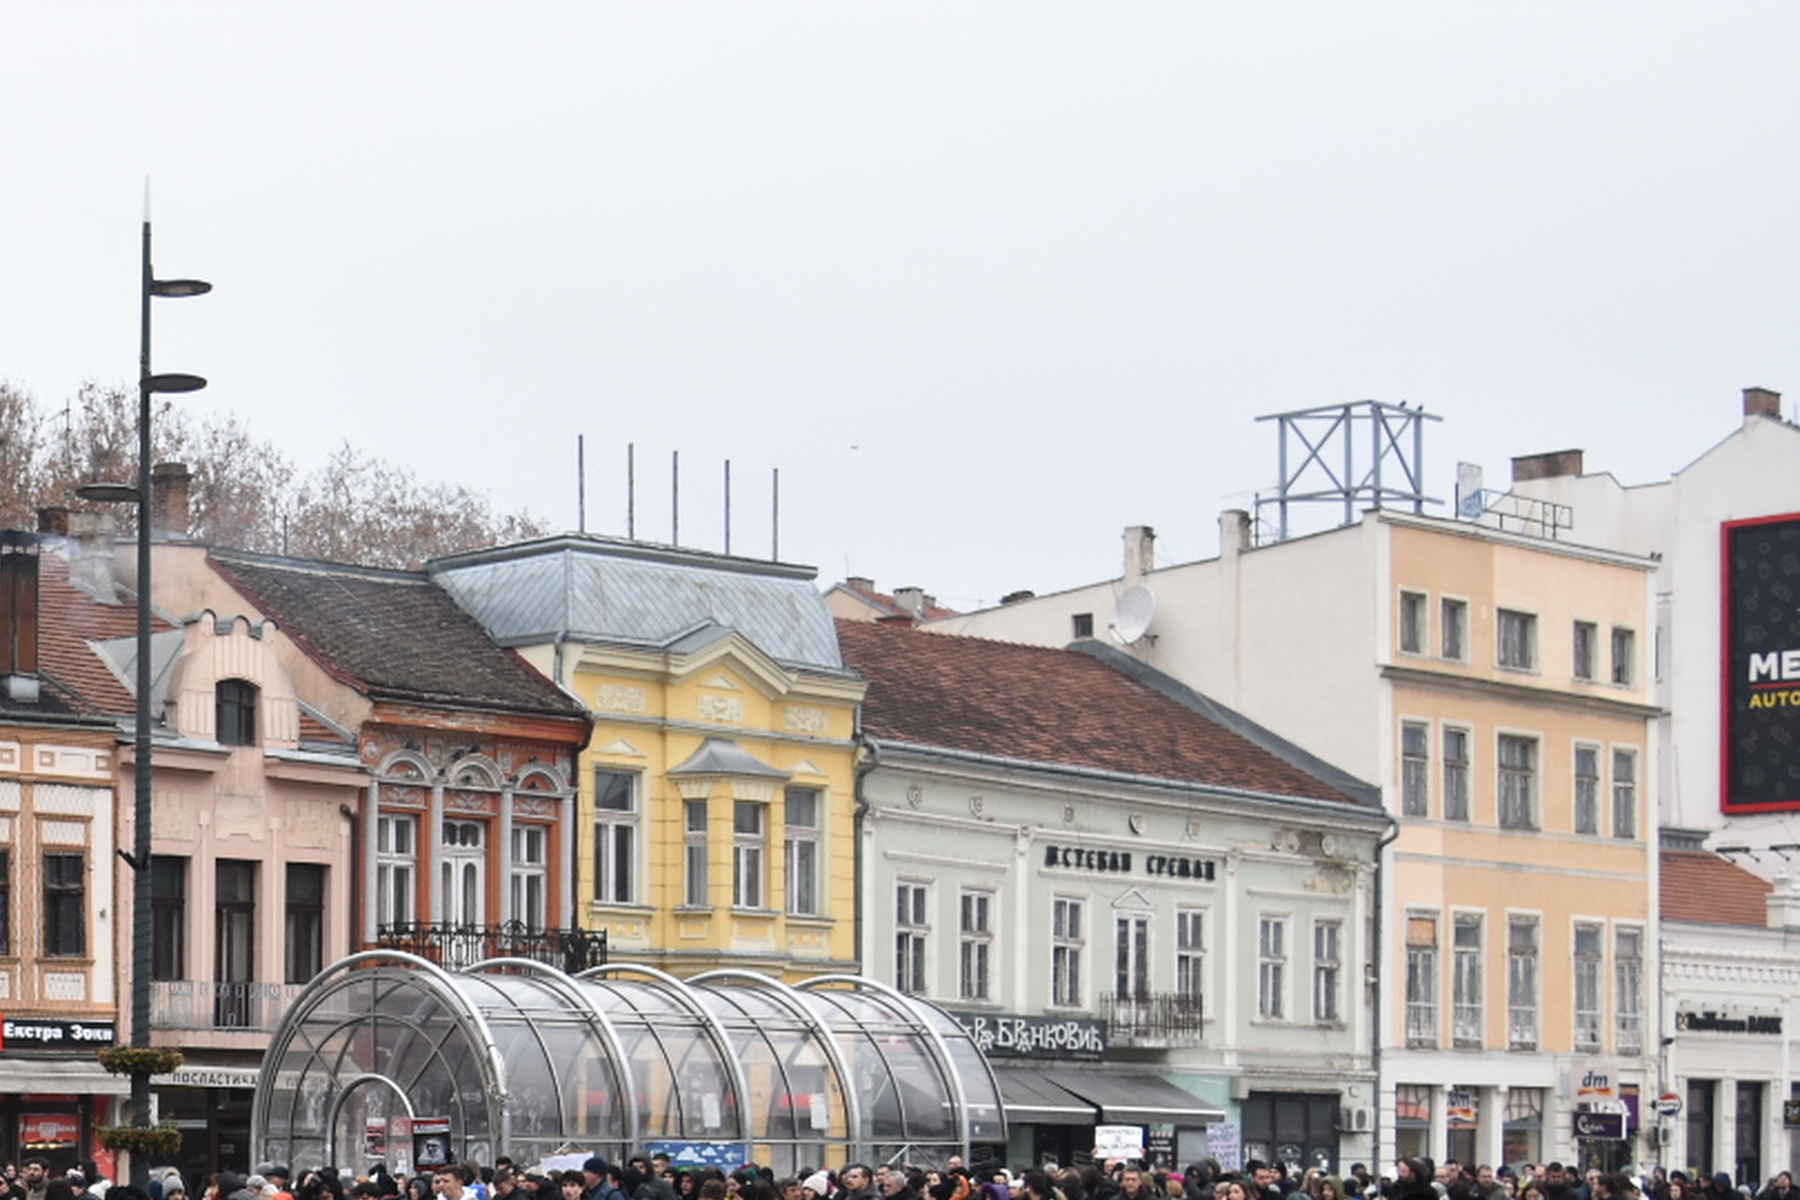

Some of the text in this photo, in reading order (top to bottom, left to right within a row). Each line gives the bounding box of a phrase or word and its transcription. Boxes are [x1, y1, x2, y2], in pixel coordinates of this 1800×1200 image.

[3, 1021, 113, 1042] Екстра Зоки
[1582, 1070, 1609, 1088] dm
